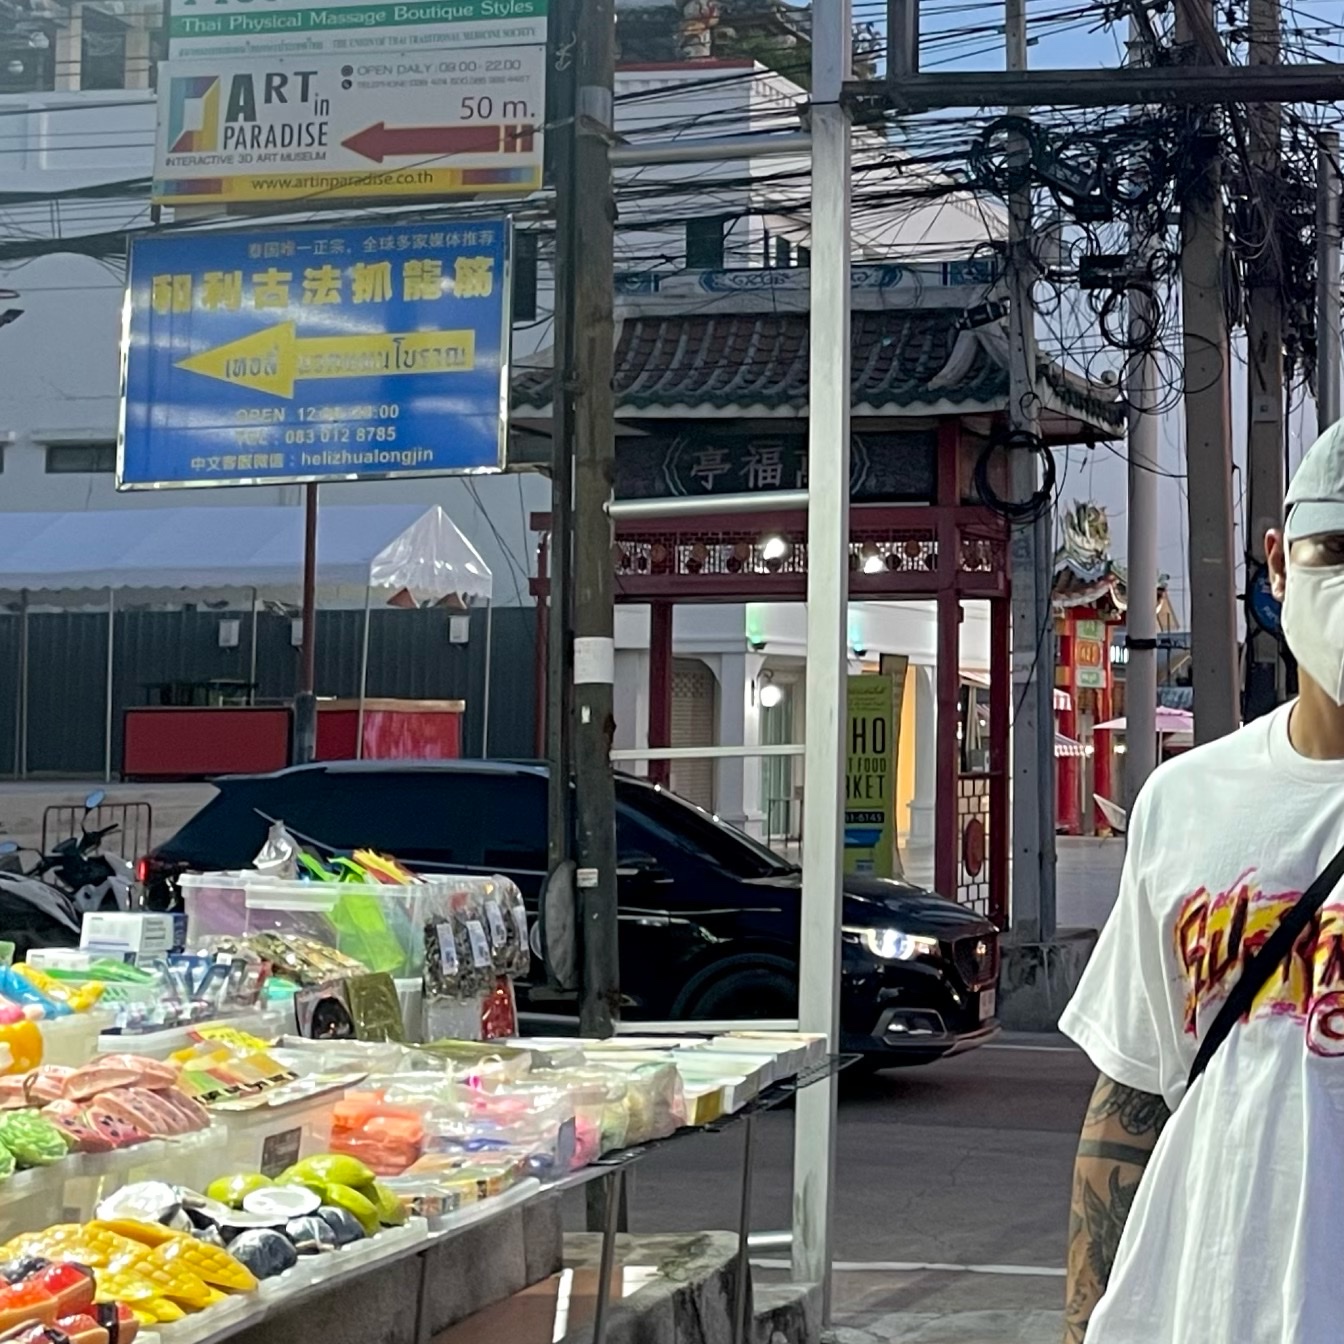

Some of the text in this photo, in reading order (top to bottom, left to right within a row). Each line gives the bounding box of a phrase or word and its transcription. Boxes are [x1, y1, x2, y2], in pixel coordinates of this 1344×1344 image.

[181, 0, 534, 33] Thai Physical Massage Boutique Styles
[357, 64, 393, 77] OPEN
[396, 62, 431, 76] DAILY
[225, 70, 318, 123] ART
[314, 92, 330, 117] in
[459, 95, 536, 120] 50 m.
[223, 121, 329, 151] PARADISE
[165, 151, 327, 167] INTERACTIVE 3D ART MUSEUM
[251, 170, 433, 191] www.artinparadise.co.th
[234, 407, 285, 423] OPEN
[285, 429, 315, 444] 083
[320, 428, 349, 443] 012
[355, 426, 396, 442] 8785
[301, 447, 434, 467] helizhualongjin
[857, 757, 887, 773] FOOD
